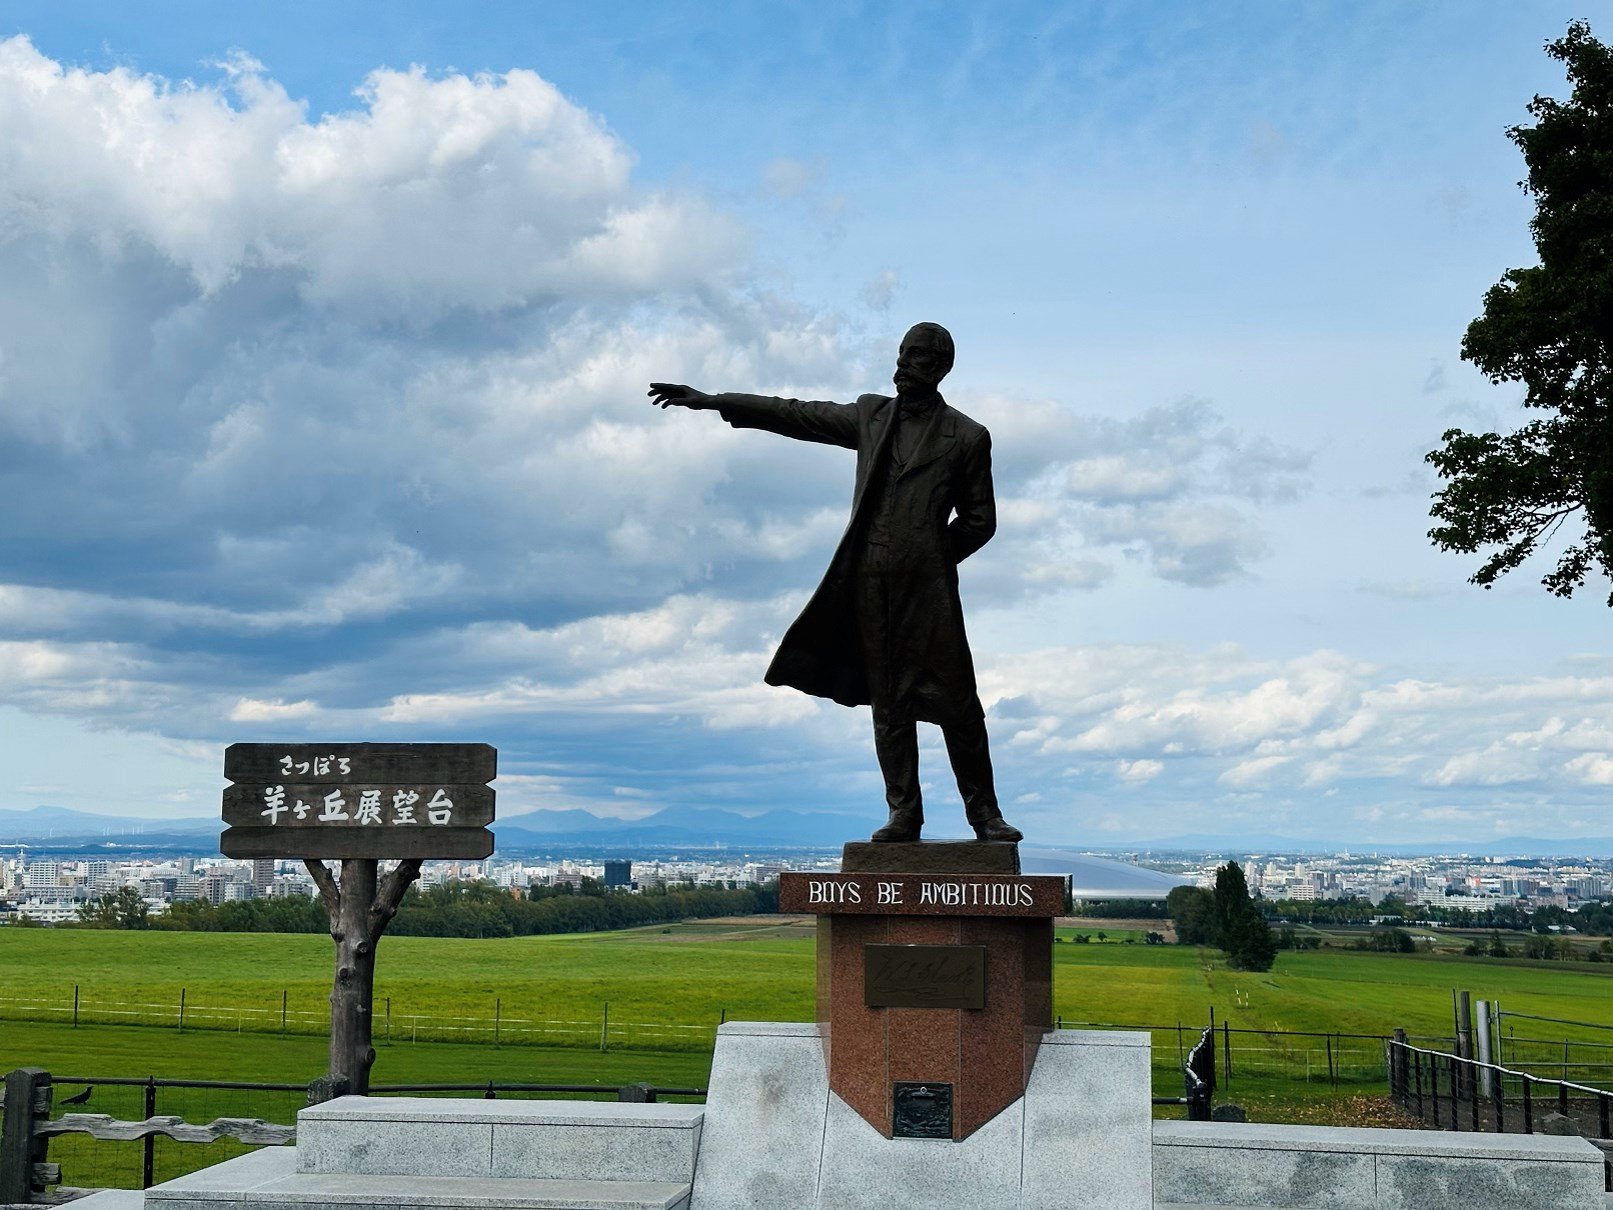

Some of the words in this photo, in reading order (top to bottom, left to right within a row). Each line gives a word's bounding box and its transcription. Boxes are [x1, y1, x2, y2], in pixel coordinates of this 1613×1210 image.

[808, 881, 862, 904] BOYS
[877, 882, 904, 905] BE
[919, 882, 1034, 907] AMBITIOUS
